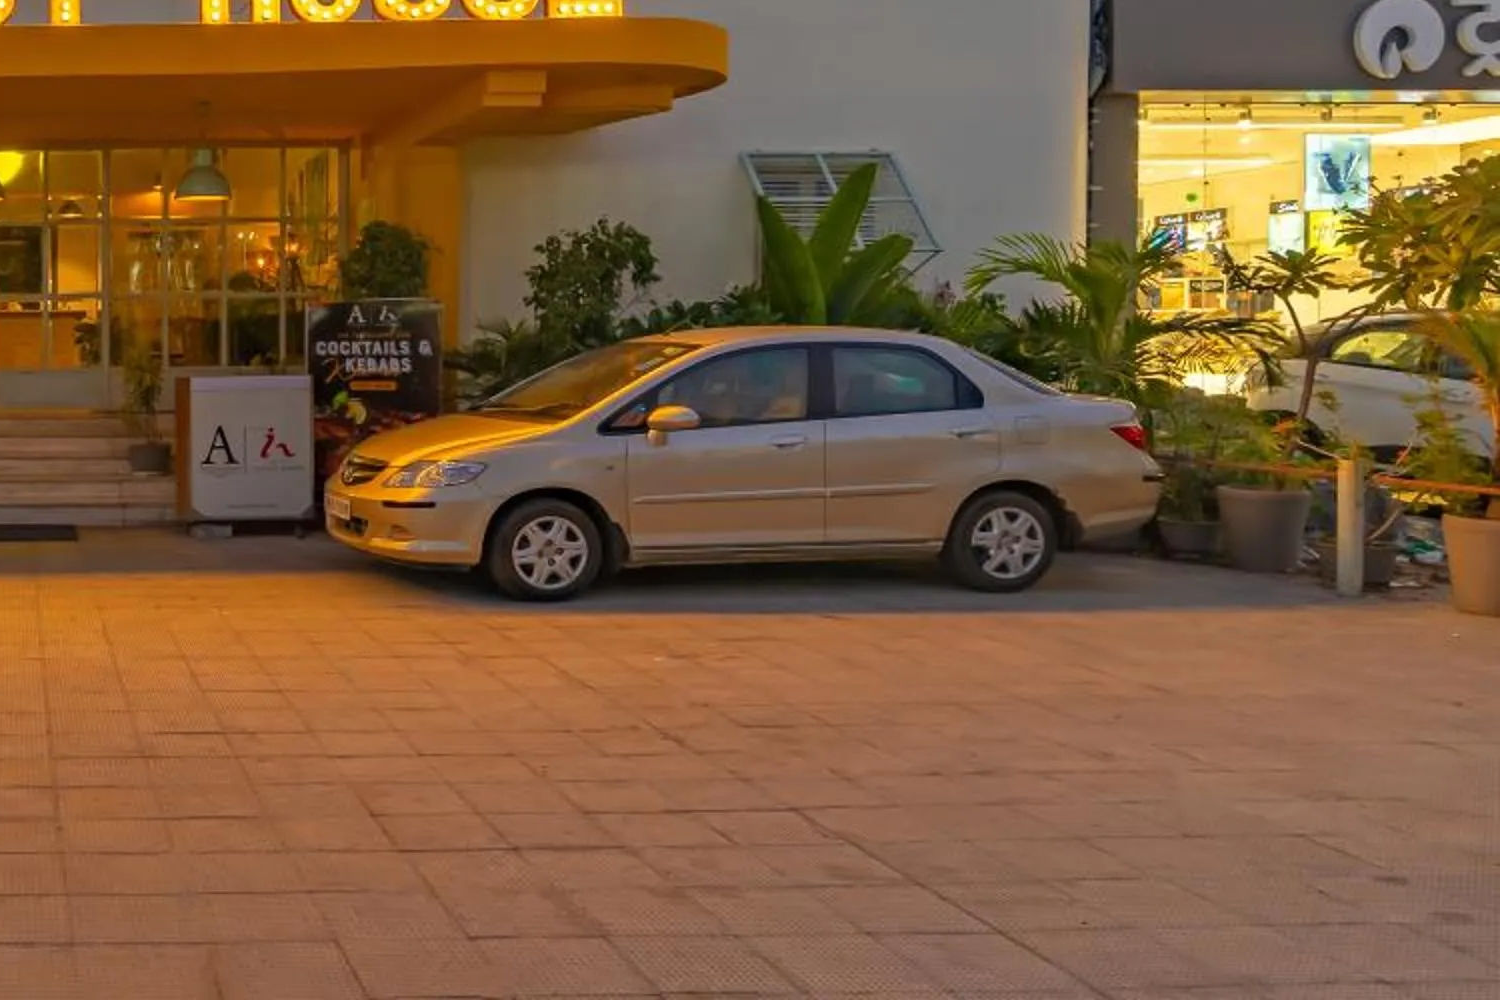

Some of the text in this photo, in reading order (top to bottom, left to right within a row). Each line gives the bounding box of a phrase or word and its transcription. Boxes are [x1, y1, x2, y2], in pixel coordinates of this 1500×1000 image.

[315, 340, 412, 357] COCKTAILS
[344, 357, 413, 374] KEBABS
[201, 424, 241, 466] A
